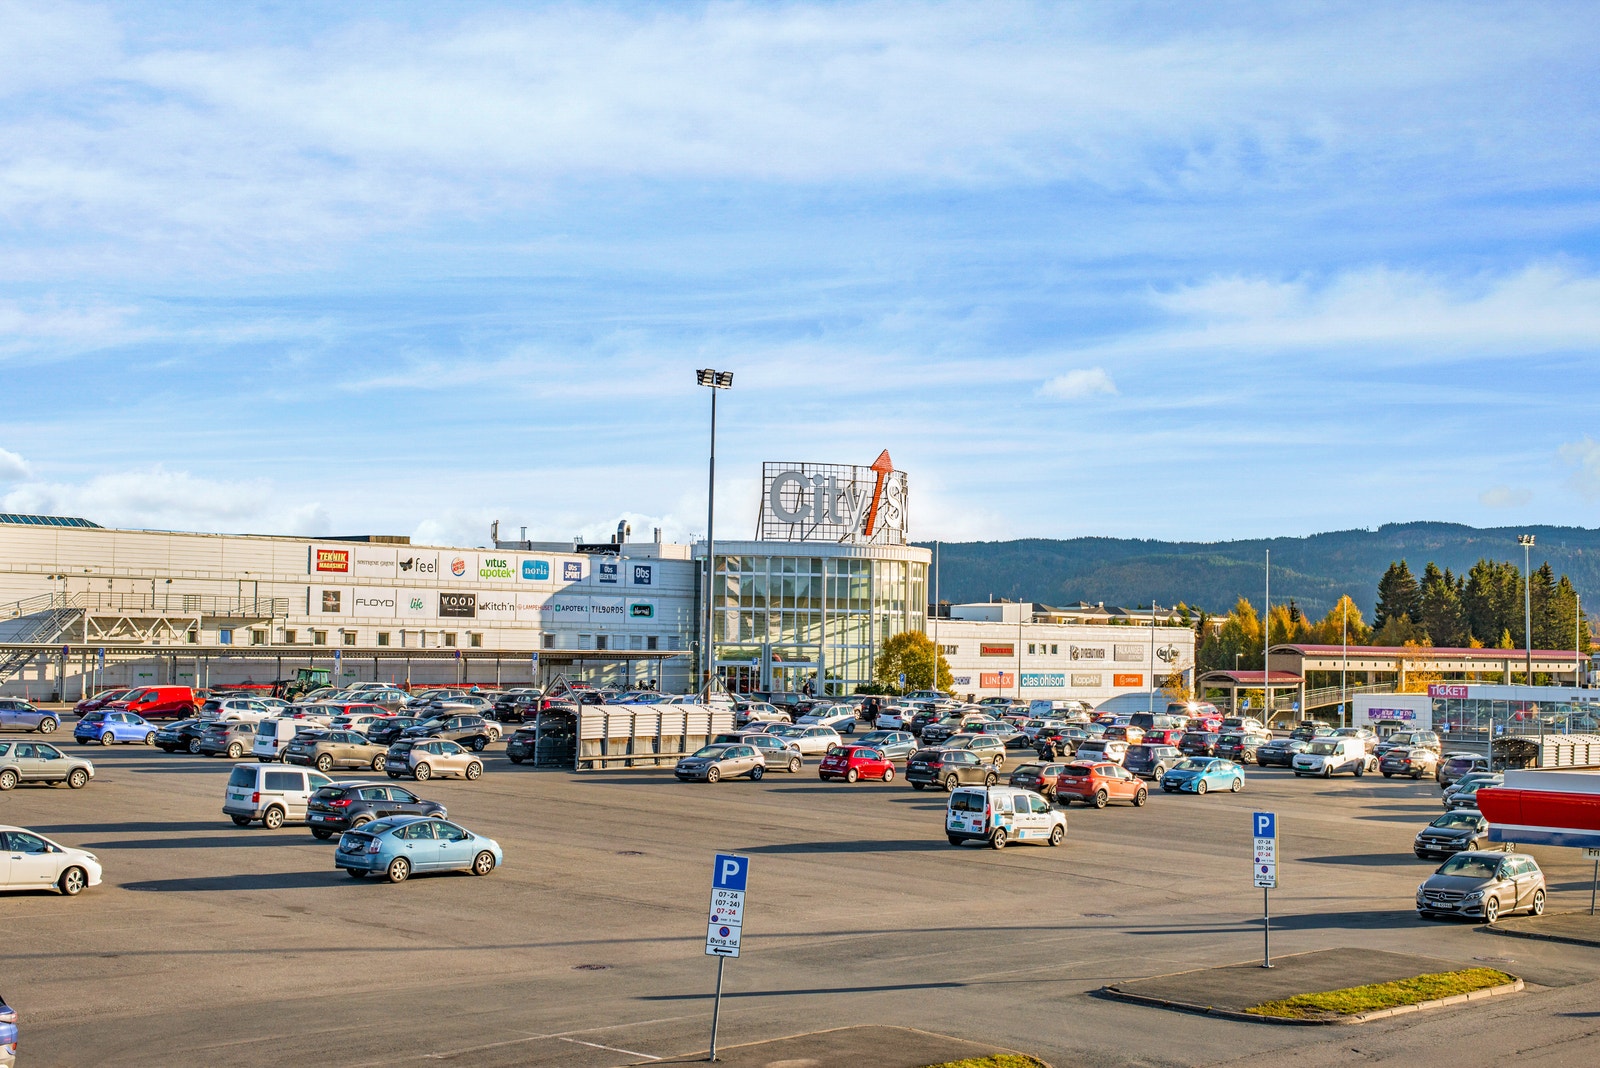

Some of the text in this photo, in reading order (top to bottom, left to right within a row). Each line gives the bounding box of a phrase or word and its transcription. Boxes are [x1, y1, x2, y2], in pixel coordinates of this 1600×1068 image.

[770, 471, 867, 534] City
[319, 552, 347, 562] TEKNIK
[415, 557, 437, 573] feel
[485, 558, 507, 568] vitus
[524, 564, 547, 575] norli
[356, 598, 394, 607] FLOYD
[410, 598, 424, 610] life
[442, 596, 474, 606] WOOD
[1022, 674, 1064, 686] clas ohlson
[1073, 675, 1100, 684] KappAhl
[1430, 686, 1465, 696] TICKET
[1258, 816, 1270, 834] P
[721, 859, 740, 884] P
[715, 899, 740, 908] (07-24)
